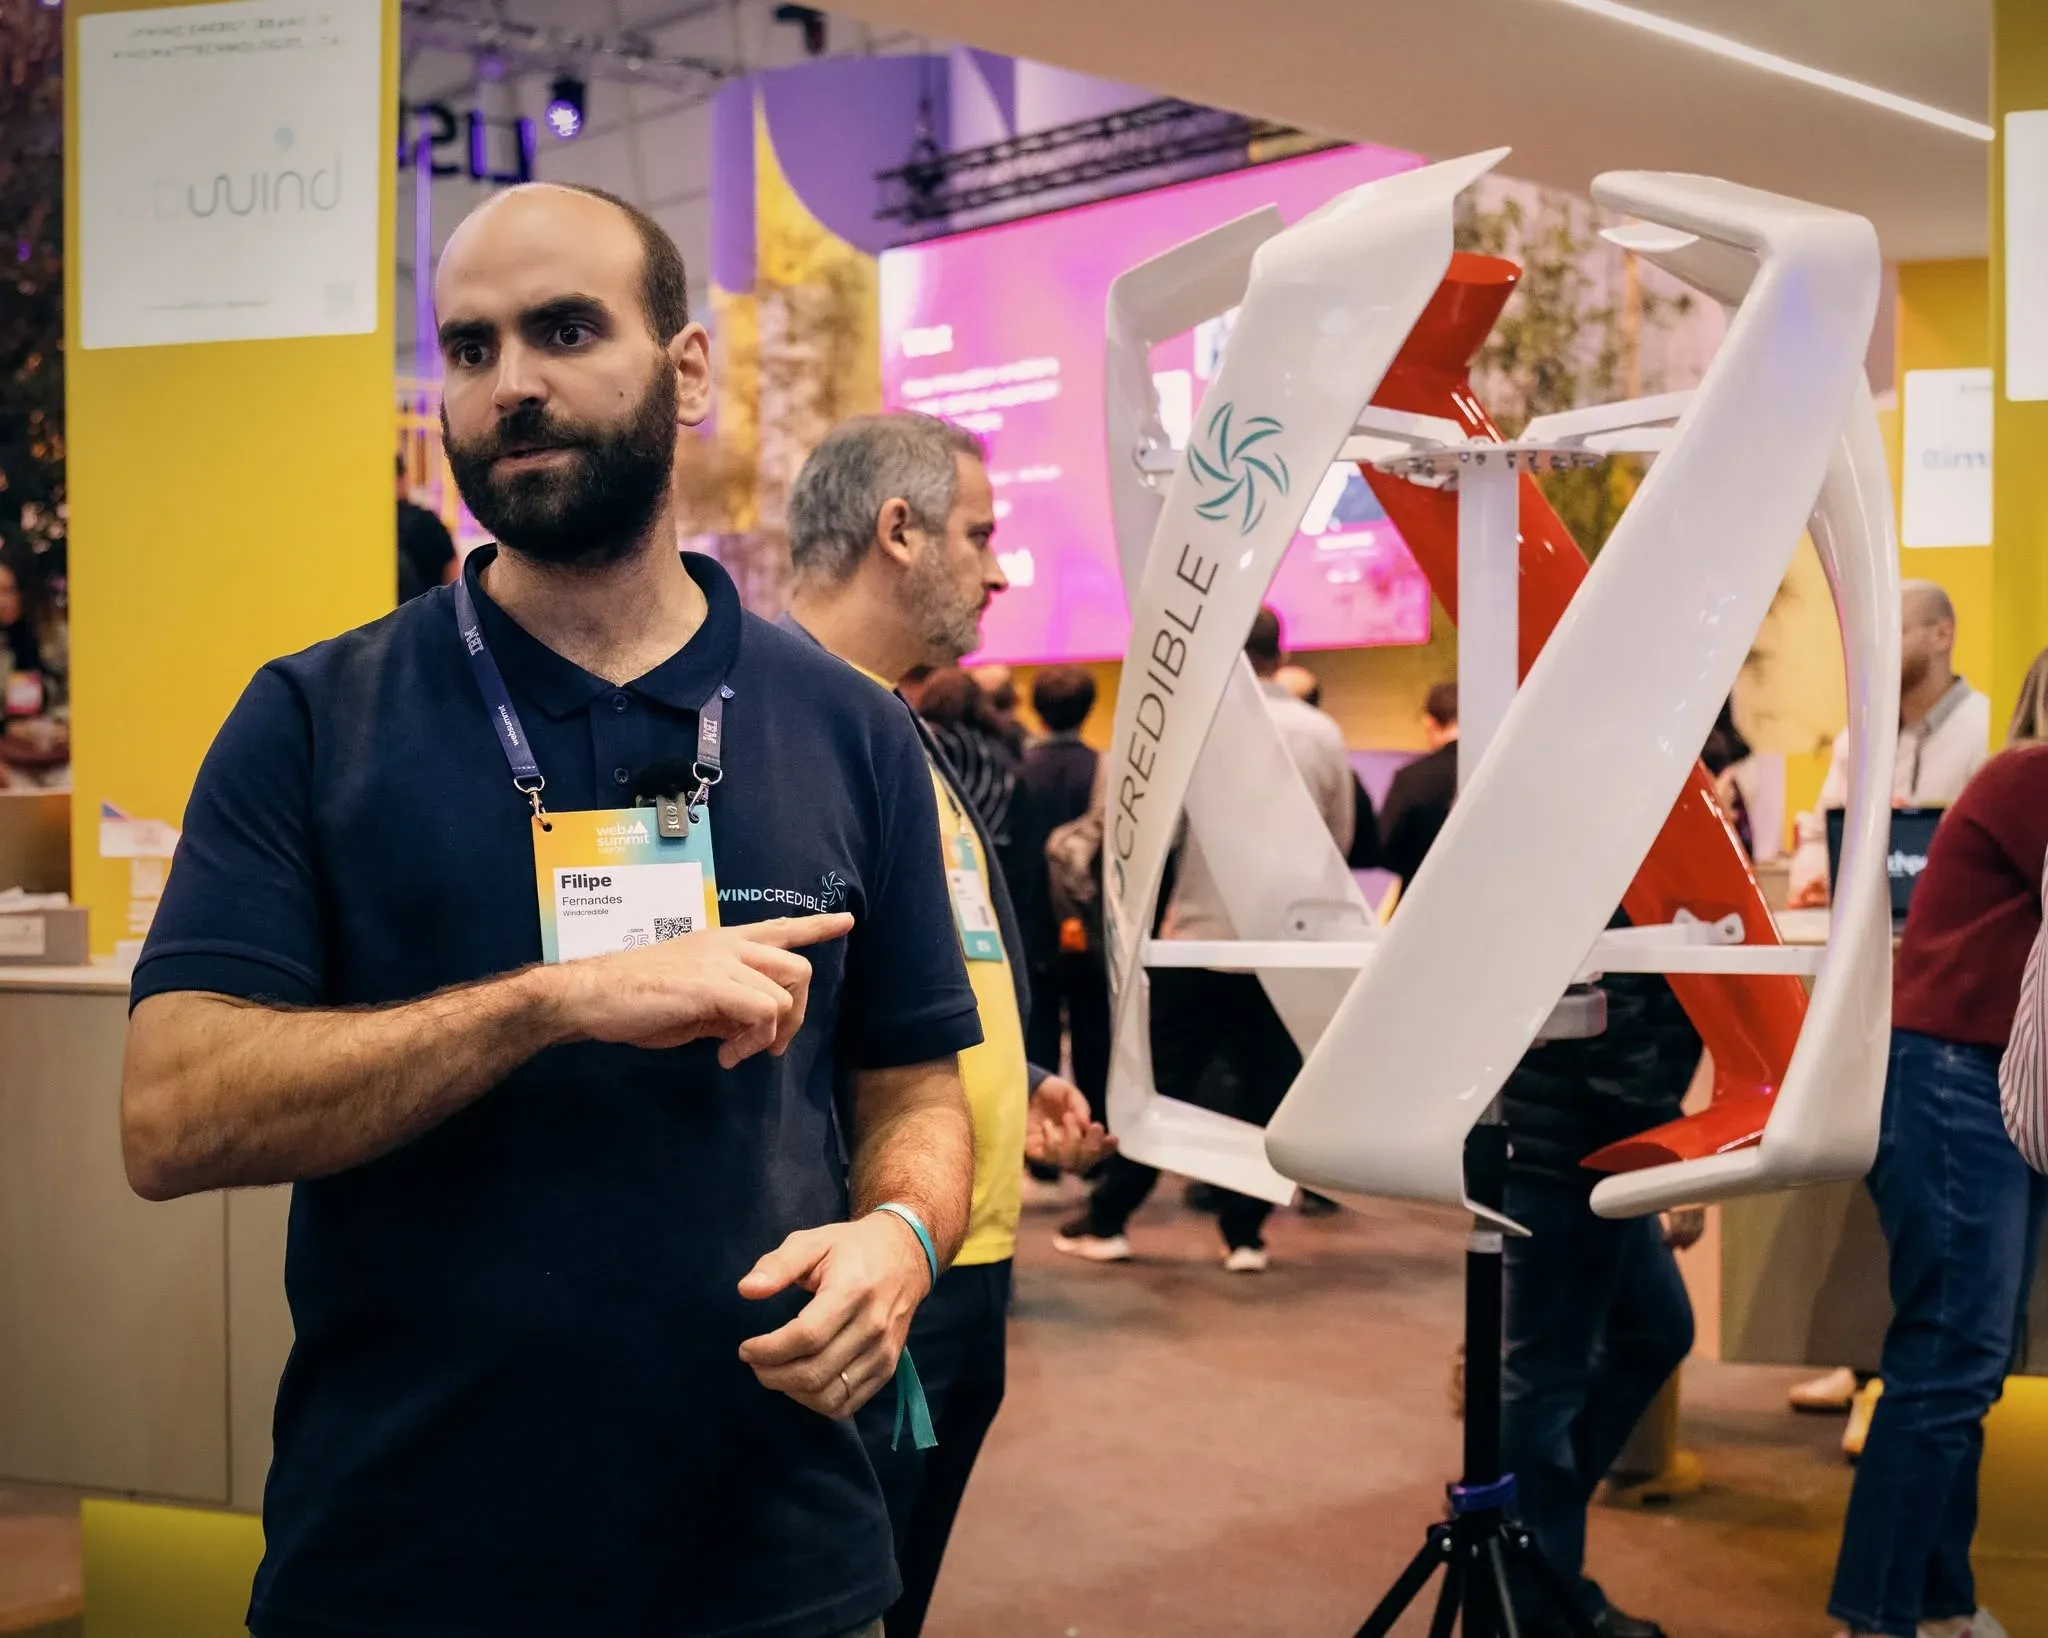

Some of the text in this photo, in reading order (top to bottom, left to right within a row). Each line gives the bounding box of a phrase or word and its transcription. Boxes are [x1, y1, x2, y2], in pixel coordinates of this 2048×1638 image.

[464, 625, 485, 656] IBM
[498, 704, 520, 747] websummit
[1113, 543, 1219, 899] CREDIBLE
[702, 716, 718, 745] IBM
[596, 822, 626, 835] web
[597, 833, 650, 847] summit
[561, 874, 613, 891] Filipe
[562, 895, 623, 906] Fernandes
[717, 888, 828, 913] WINDCREDIBLE
[562, 908, 609, 916] Windcredible
[622, 934, 650, 952] 25
